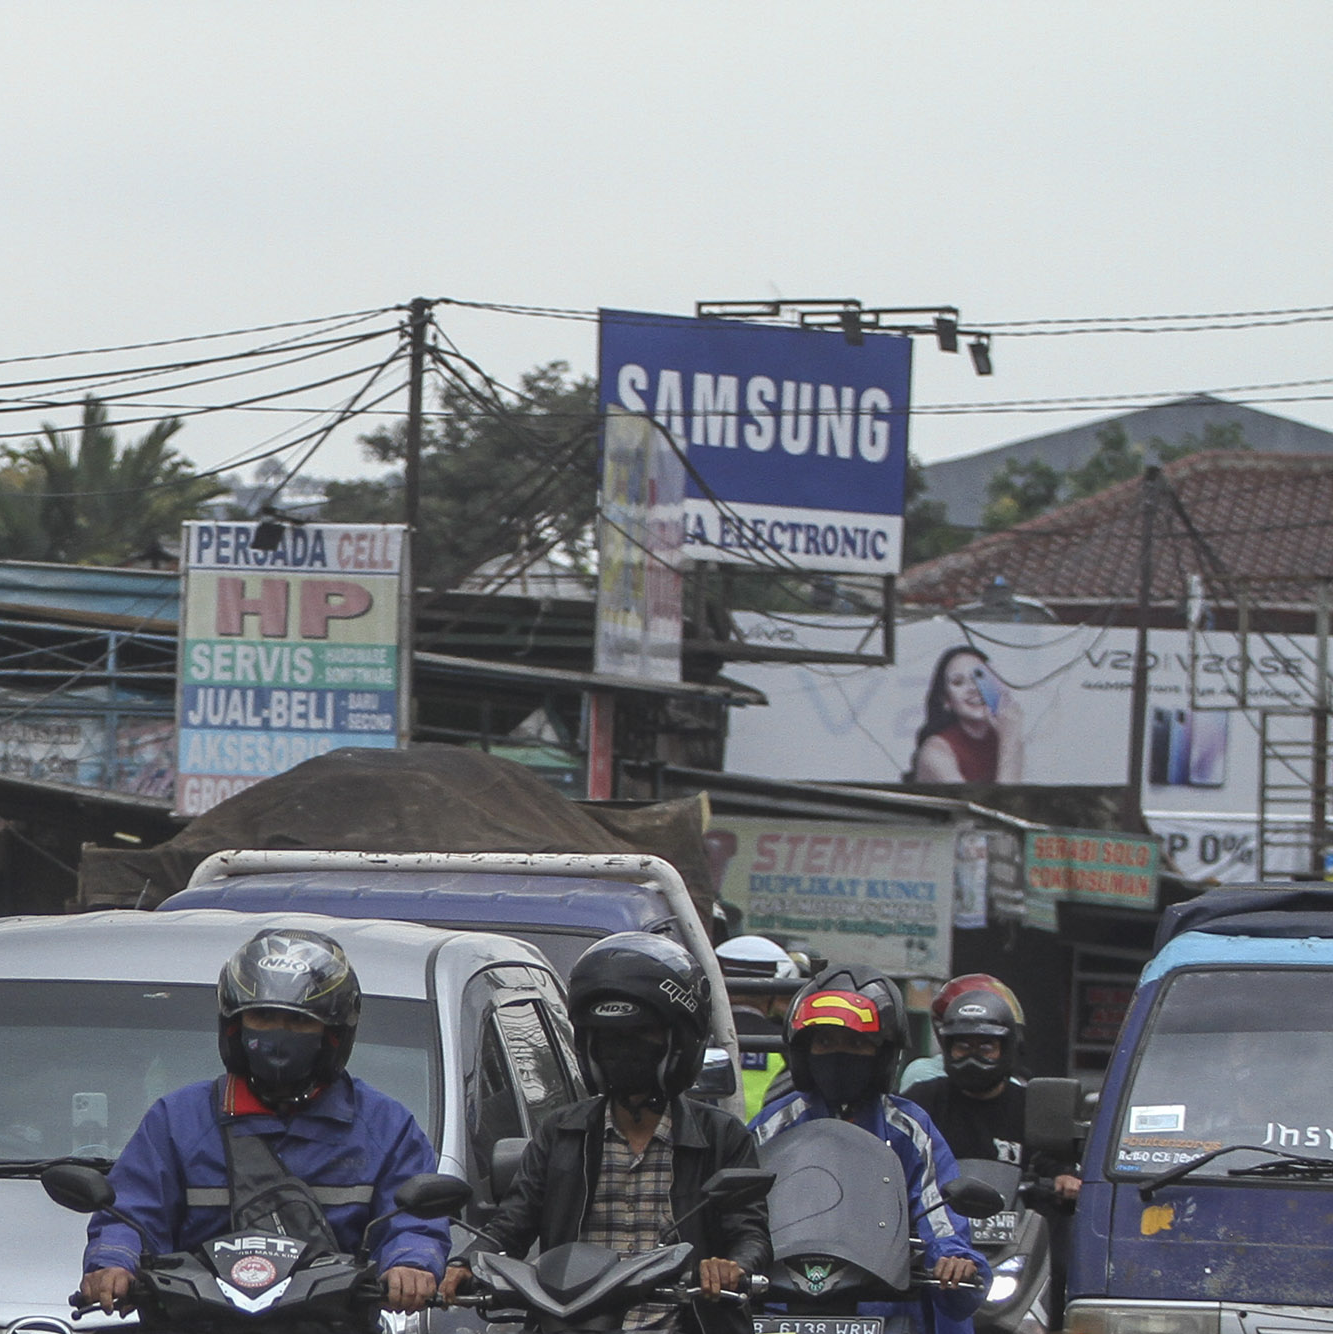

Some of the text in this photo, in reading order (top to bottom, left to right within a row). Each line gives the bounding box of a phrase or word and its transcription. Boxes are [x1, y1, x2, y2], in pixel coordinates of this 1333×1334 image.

[618, 364, 892, 463] SAMSUNG
[336, 532, 395, 570] CELL
[720, 514, 888, 561] ELECTRONIC
[215, 577, 374, 640] HP
[190, 643, 314, 684] SERVIS
[188, 687, 335, 730] JUAL-BELI
[751, 833, 936, 877] STEMPEL
[1102, 841, 1151, 868] SOLO
[749, 874, 862, 897] DUPLIKAT
[598, 1004, 632, 1013] MDS
[214, 1236, 298, 1254] NET.
